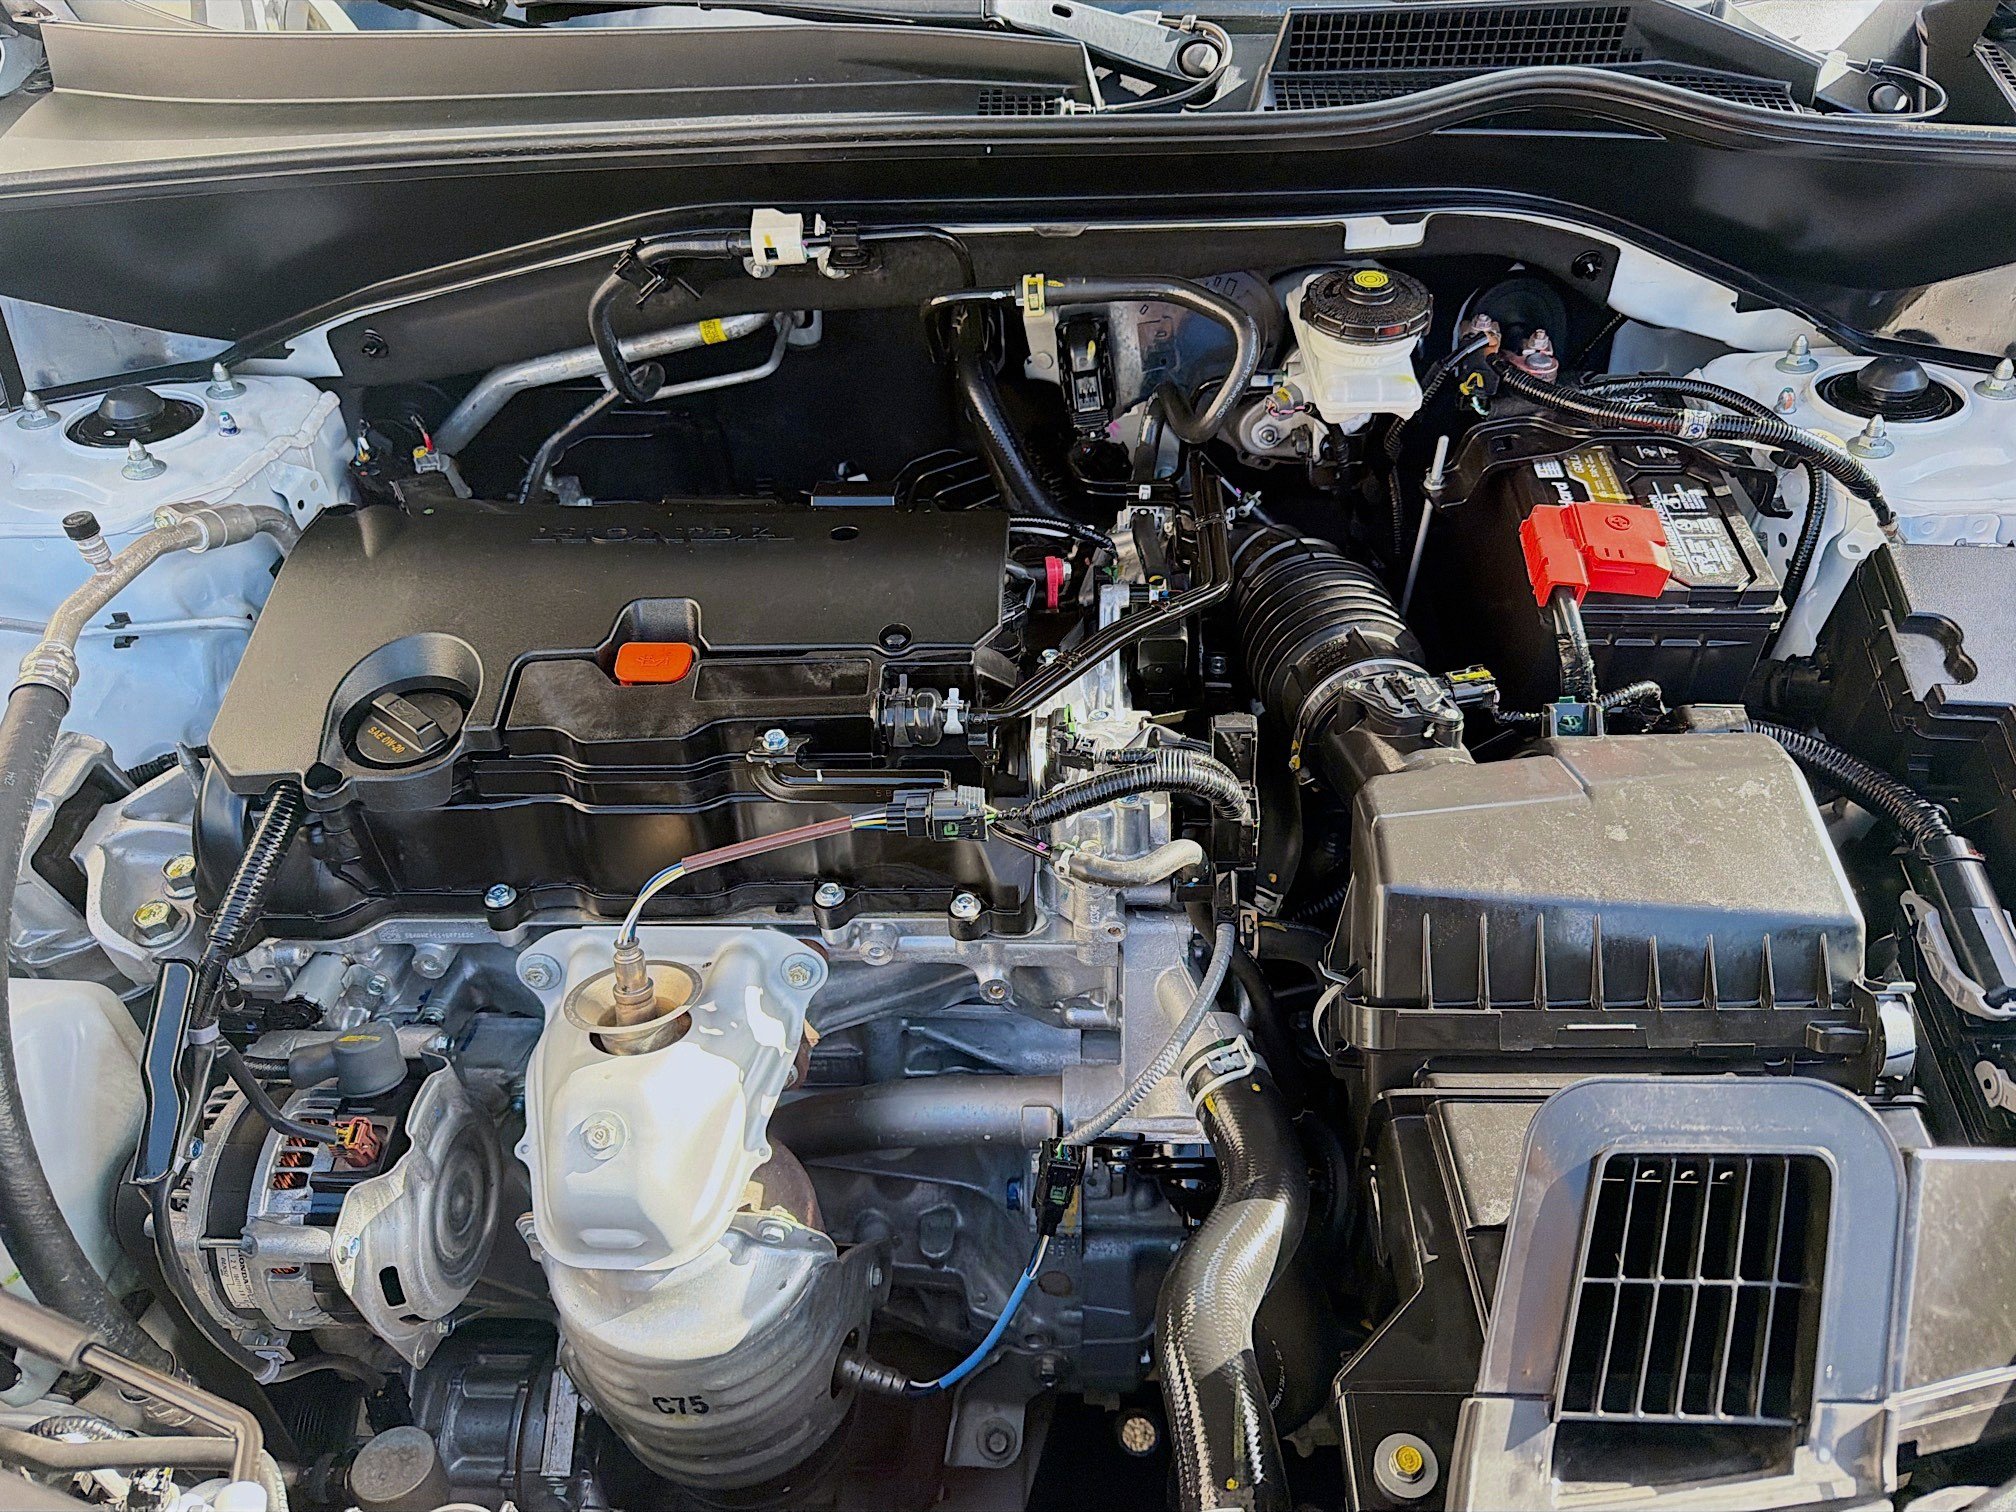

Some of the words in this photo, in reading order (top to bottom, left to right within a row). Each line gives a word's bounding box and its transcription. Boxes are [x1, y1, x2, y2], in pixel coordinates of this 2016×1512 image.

[368, 726, 386, 740] SAE
[381, 736, 406, 754] 0W-20
[652, 1394, 710, 1415] C75
